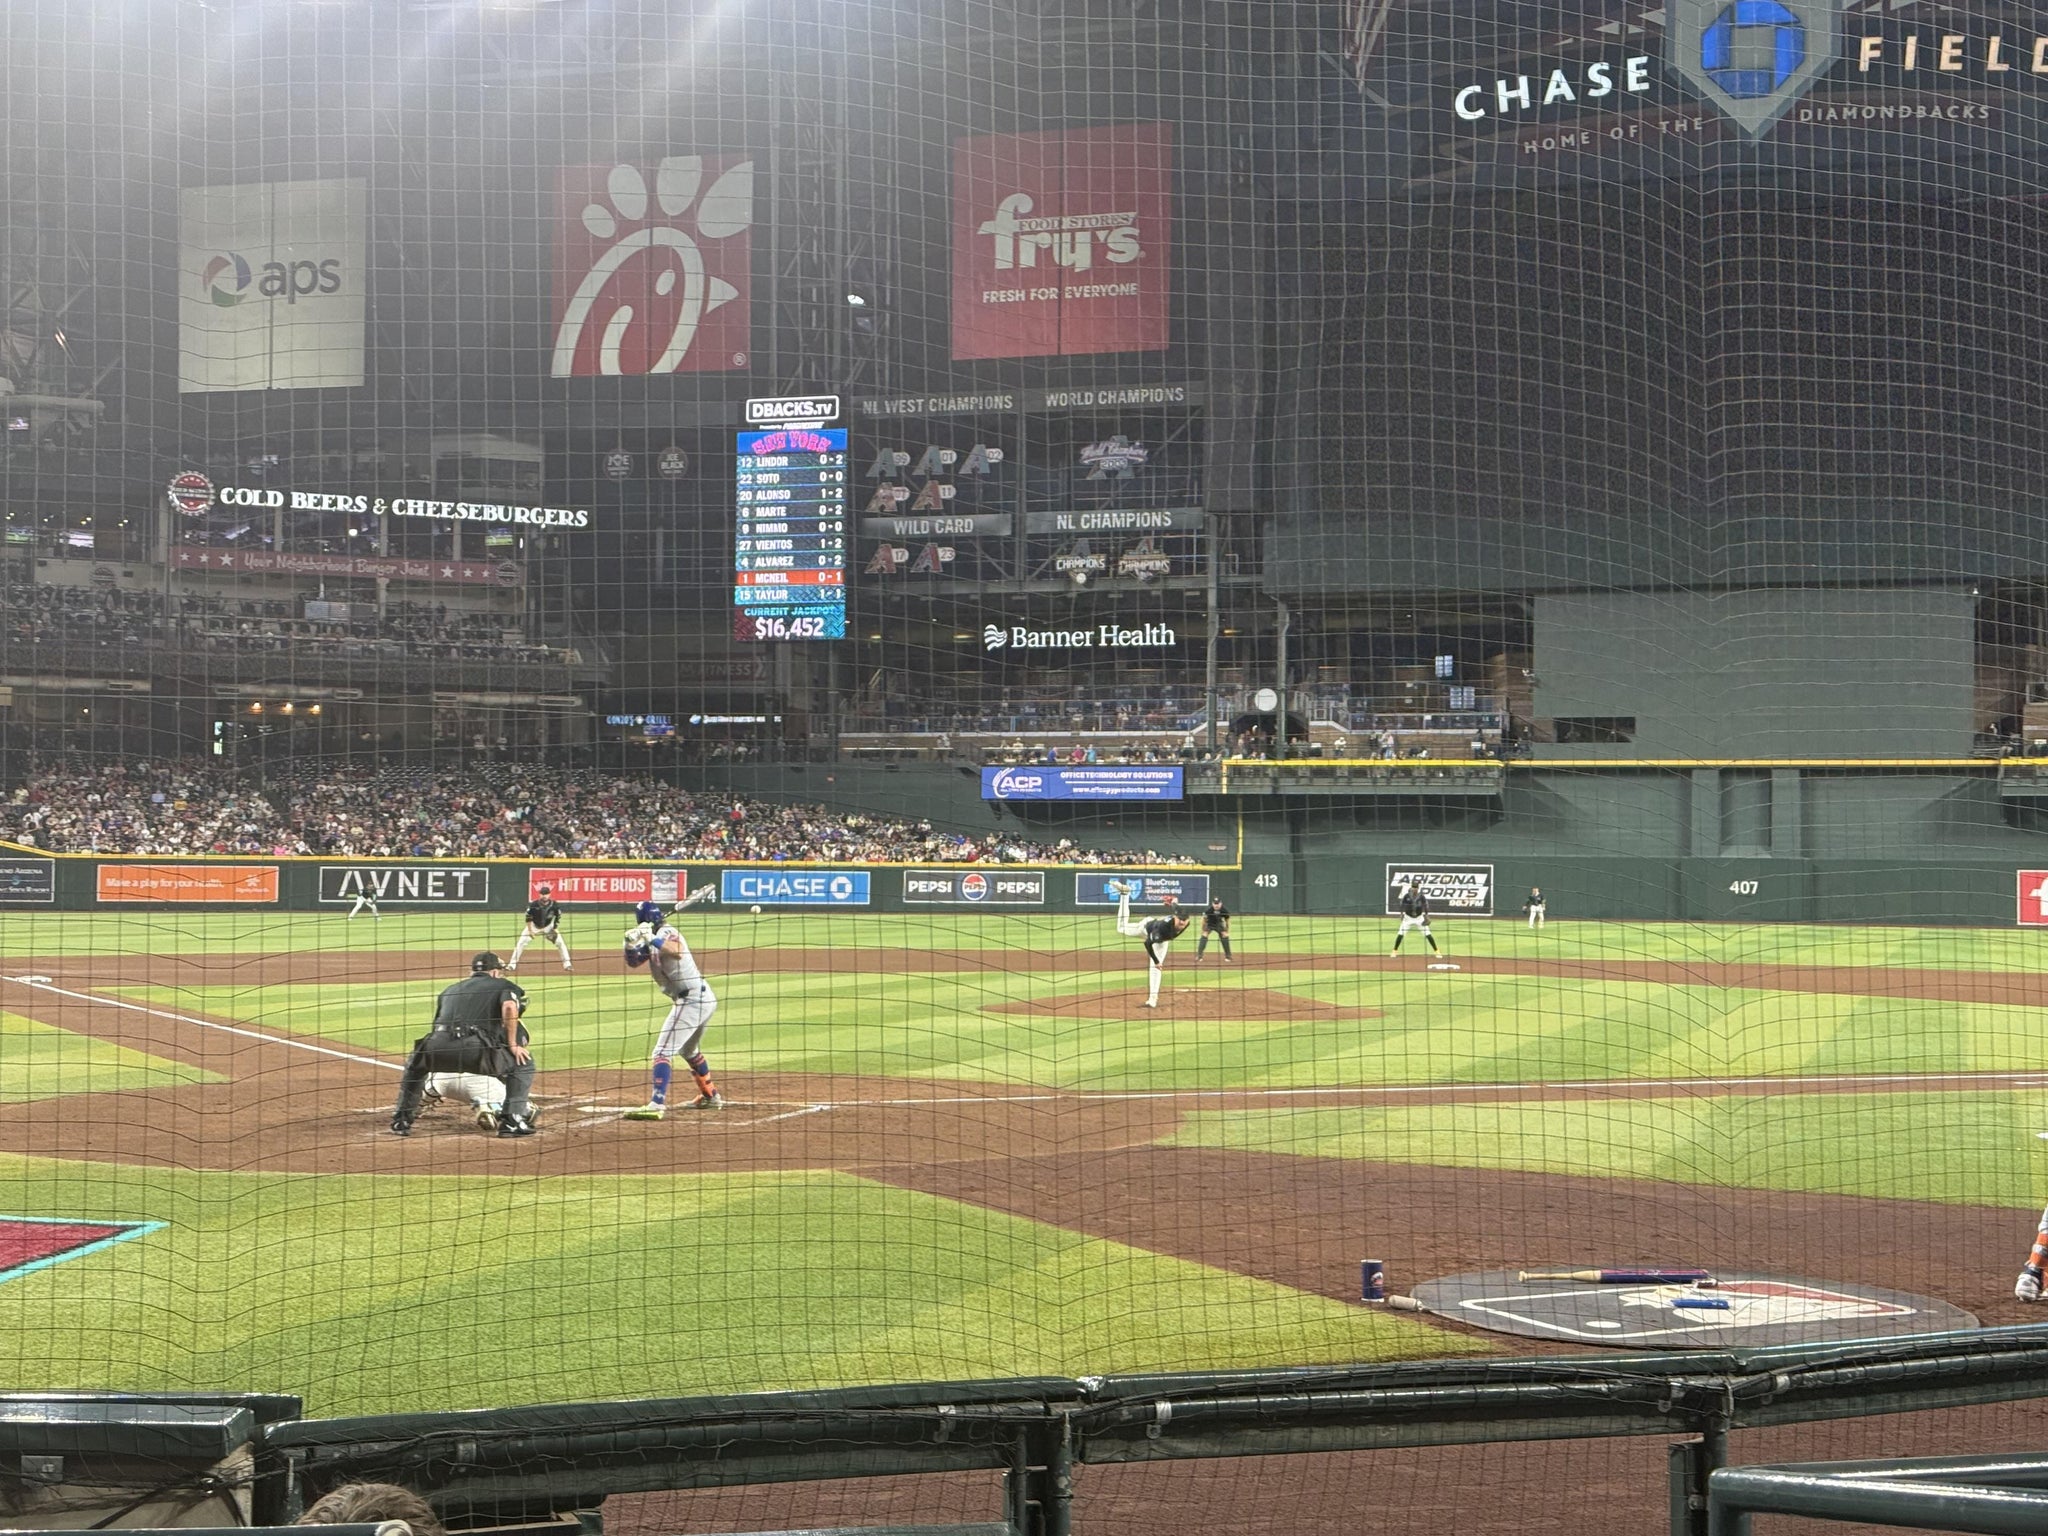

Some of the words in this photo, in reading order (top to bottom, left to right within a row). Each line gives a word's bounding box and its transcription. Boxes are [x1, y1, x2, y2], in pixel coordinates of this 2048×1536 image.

[1454, 55, 1650, 120] CHASE
[1524, 131, 1591, 154] HOME
[1610, 125, 1639, 140] OF
[1659, 117, 1702, 134] THE
[1801, 104, 1990, 122] DIAMONDBACKS
[1019, 217, 1061, 231] FOOD
[1069, 213, 1131, 229] STORES
[977, 193, 1140, 273] fry's
[258, 258, 341, 305] aps
[982, 290, 1025, 304] FRESH
[1030, 287, 1058, 301] FOR
[1064, 283, 1138, 299] EVERYONE
[1045, 391, 1093, 407] WORLD
[1098, 387, 1184, 405] CHAMPIONS
[752, 401, 832, 418] DBACKS.TV
[863, 400, 880, 415] NL
[885, 399, 924, 413] WEST
[929, 395, 1013, 412] CHAMPIONS
[741, 458, 752, 467] 12
[757, 456, 788, 467] LINDOR
[741, 474, 752, 484] 22
[756, 473, 780, 484] SOTO
[741, 490, 752, 501] 20
[756, 490, 791, 500] ALONSO
[220, 487, 284, 507] COLD
[290, 491, 368, 513] BEERS
[372, 498, 388, 515] &
[392, 498, 588, 527] CHEESEBURGERS
[742, 507, 750, 517] 6
[756, 506, 787, 517] MARTE
[894, 519, 929, 535] WILD
[935, 518, 973, 534] CARD
[1057, 514, 1076, 530] NL
[1081, 511, 1172, 529] CHAMPIONS
[740, 541, 752, 551] 27
[756, 539, 793, 550] VIENTOS
[741, 557, 749, 567] 4
[755, 556, 794, 567] ALVAREZ
[940, 549, 953, 560] 23
[244, 552, 273, 570] Your
[276, 555, 353, 572] Neighborhood
[357, 558, 397, 576] Burger
[400, 561, 430, 577] Joint
[1056, 558, 1105, 570] CHAMPIONS
[743, 573, 748, 584] 1
[755, 572, 789, 583] MCNEIL
[740, 590, 751, 600] 15
[755, 589, 788, 600] TAYLOR
[744, 607, 789, 617] CURRENT
[755, 616, 824, 640] $16,452
[1011, 626, 1094, 648] Banner
[1099, 622, 1176, 647] Health
[1060, 771, 1084, 779] OFFICE
[1133, 771, 1174, 779] SOLUTIONS
[1000, 776, 1042, 789] ACP
[105, 877, 131, 888] Make
[140, 878, 159, 890] play
[160, 878, 172, 888] for
[174, 880, 193, 890] your
[337, 870, 471, 898] AVNET
[558, 877, 579, 892] HIT
[583, 877, 607, 893] THE
[610, 877, 646, 893] BUDS
[908, 880, 952, 893] PEPSI
[1145, 878, 1180, 886] BlueCross
[1254, 874, 1278, 888] 413
[1397, 874, 1478, 885] ARIZONA
[740, 877, 826, 897] CHASE
[997, 881, 1040, 894] PEPSI
[1412, 887, 1480, 898] PORTS
[1729, 880, 1759, 895] 407
